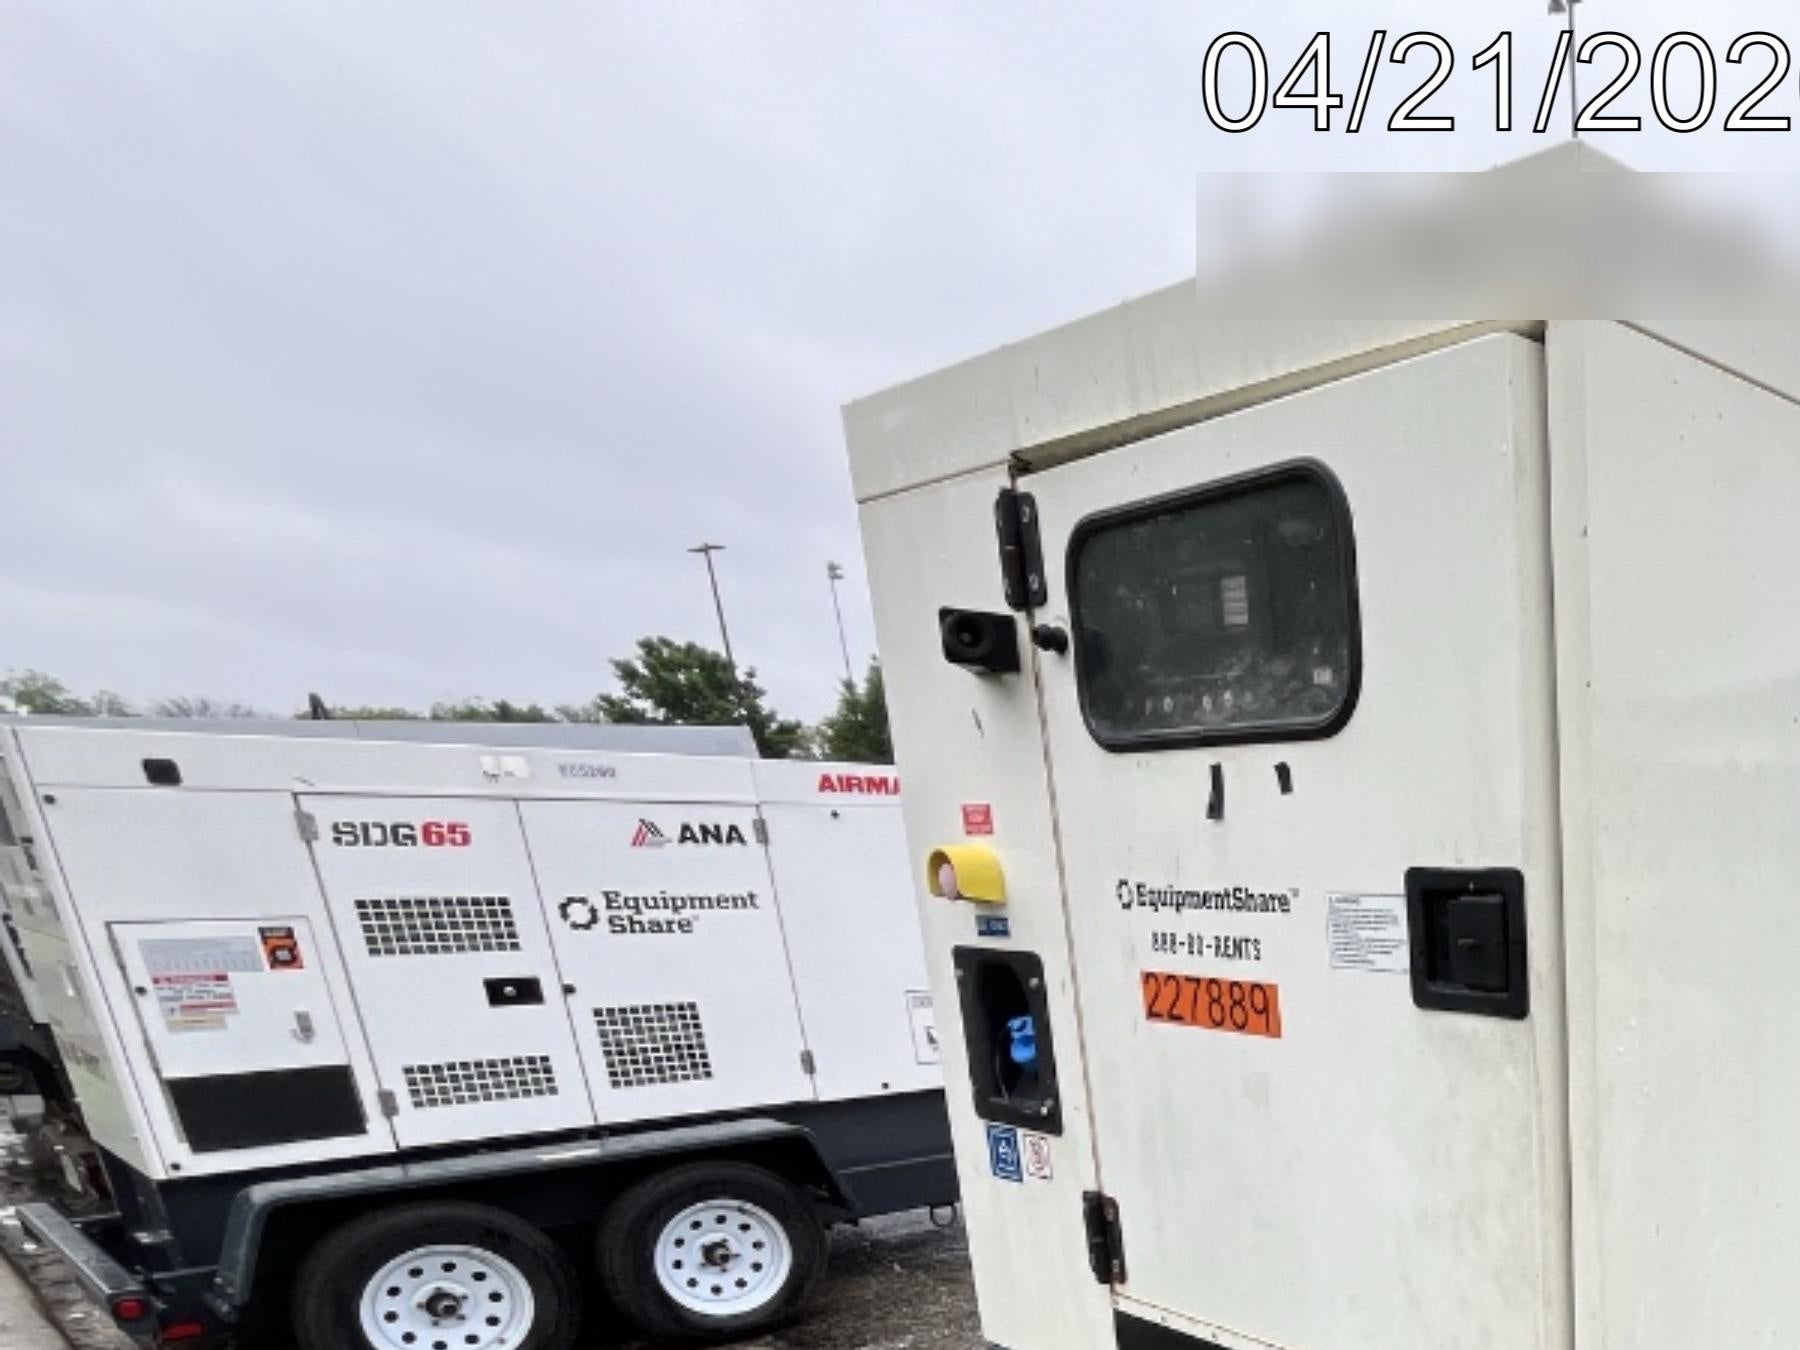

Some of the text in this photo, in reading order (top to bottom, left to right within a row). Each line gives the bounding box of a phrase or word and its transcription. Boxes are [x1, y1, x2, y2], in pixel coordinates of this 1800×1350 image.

[331, 821, 472, 847] SDG65
[678, 821, 747, 845] ANA
[601, 890, 761, 915] Equipment
[608, 914, 694, 934] Share
[1144, 972, 1270, 1032] 227889
